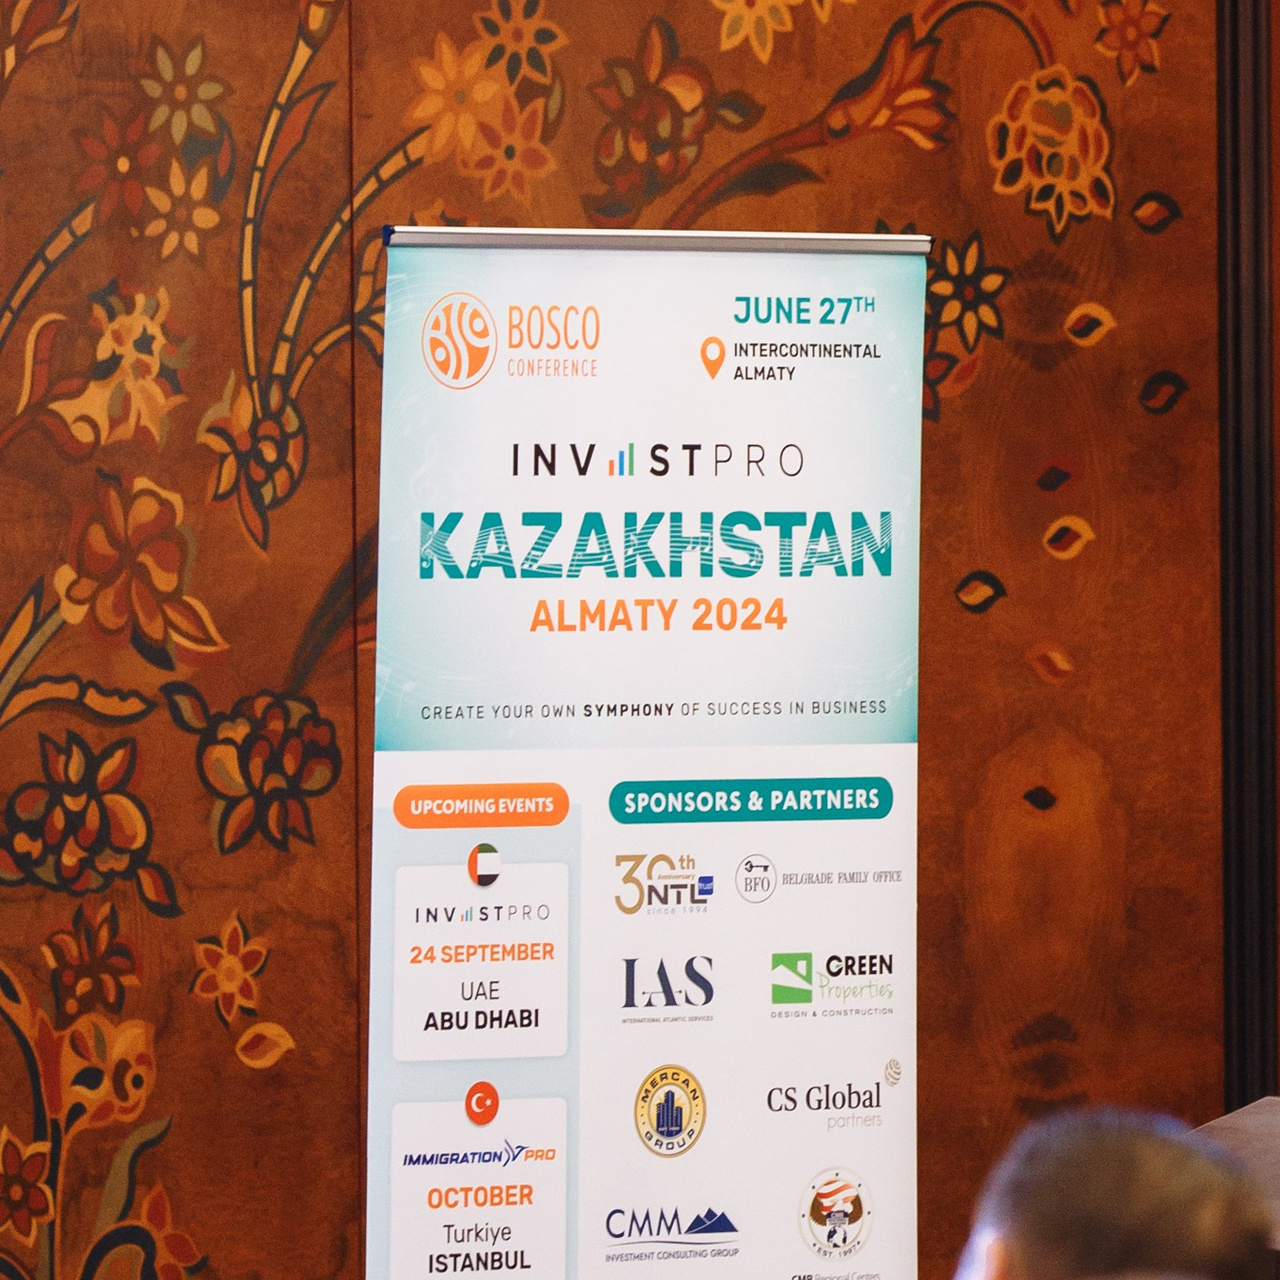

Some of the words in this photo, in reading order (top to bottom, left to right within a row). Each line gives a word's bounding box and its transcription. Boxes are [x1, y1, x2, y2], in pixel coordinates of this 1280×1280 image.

[734, 297, 811, 324] JUNE
[508, 305, 600, 350] BOSCO
[735, 343, 881, 358] INTERCONTINENTAL
[508, 359, 597, 377] CONFERENCE
[734, 366, 795, 380] ALMATY
[420, 511, 892, 579] KAZAKHSTAN
[530, 599, 678, 632] ALMATY
[692, 598, 787, 631] 2024
[421, 706, 484, 720] CREATE
[492, 705, 533, 718] YOUR
[541, 705, 575, 718] OWN
[584, 704, 673, 717] SYMPHONY
[681, 703, 699, 716] OF
[708, 702, 782, 715] SUCCESS
[790, 702, 804, 714] IN
[812, 700, 886, 714] BUSINESS
[411, 799, 496, 815] UPCOMING
[499, 797, 554, 813] EVENTS
[625, 791, 741, 813] SPONSORS
[748, 791, 763, 811] &
[771, 789, 879, 810] PARTNERS
[744, 877, 771, 892] BFO
[782, 873, 833, 885] BELGRADE
[837, 871, 869, 884] FAMILY
[872, 870, 902, 882] OFFICE
[647, 883, 708, 906] NTL
[410, 946, 436, 964] 24
[441, 943, 554, 963] SEPTEMBER
[826, 955, 893, 977] GREEN
[462, 981, 499, 1001] UAE
[622, 956, 713, 1008] IAS
[817, 972, 894, 1003] Properties
[424, 1011, 468, 1031] ABU
[475, 1009, 538, 1029] DHABI
[812, 1010, 818, 1018] &
[822, 1008, 893, 1017] CONSTRUCTION
[641, 1072, 699, 1103] MERCAN
[767, 1087, 797, 1111] CS
[806, 1082, 881, 1110] Global
[645, 1129, 695, 1150] GROUP
[403, 1151, 502, 1166] IMMIGRATION
[524, 1148, 556, 1161] PRO
[428, 1185, 533, 1209] OCTOBER
[606, 1207, 682, 1239] CMM
[443, 1223, 511, 1246] Turkiye
[429, 1250, 531, 1273] ISTANBUL
[606, 1252, 654, 1262] INVESTMENT
[657, 1250, 708, 1261] CONSULTING
[710, 1248, 740, 1259] GROUP
